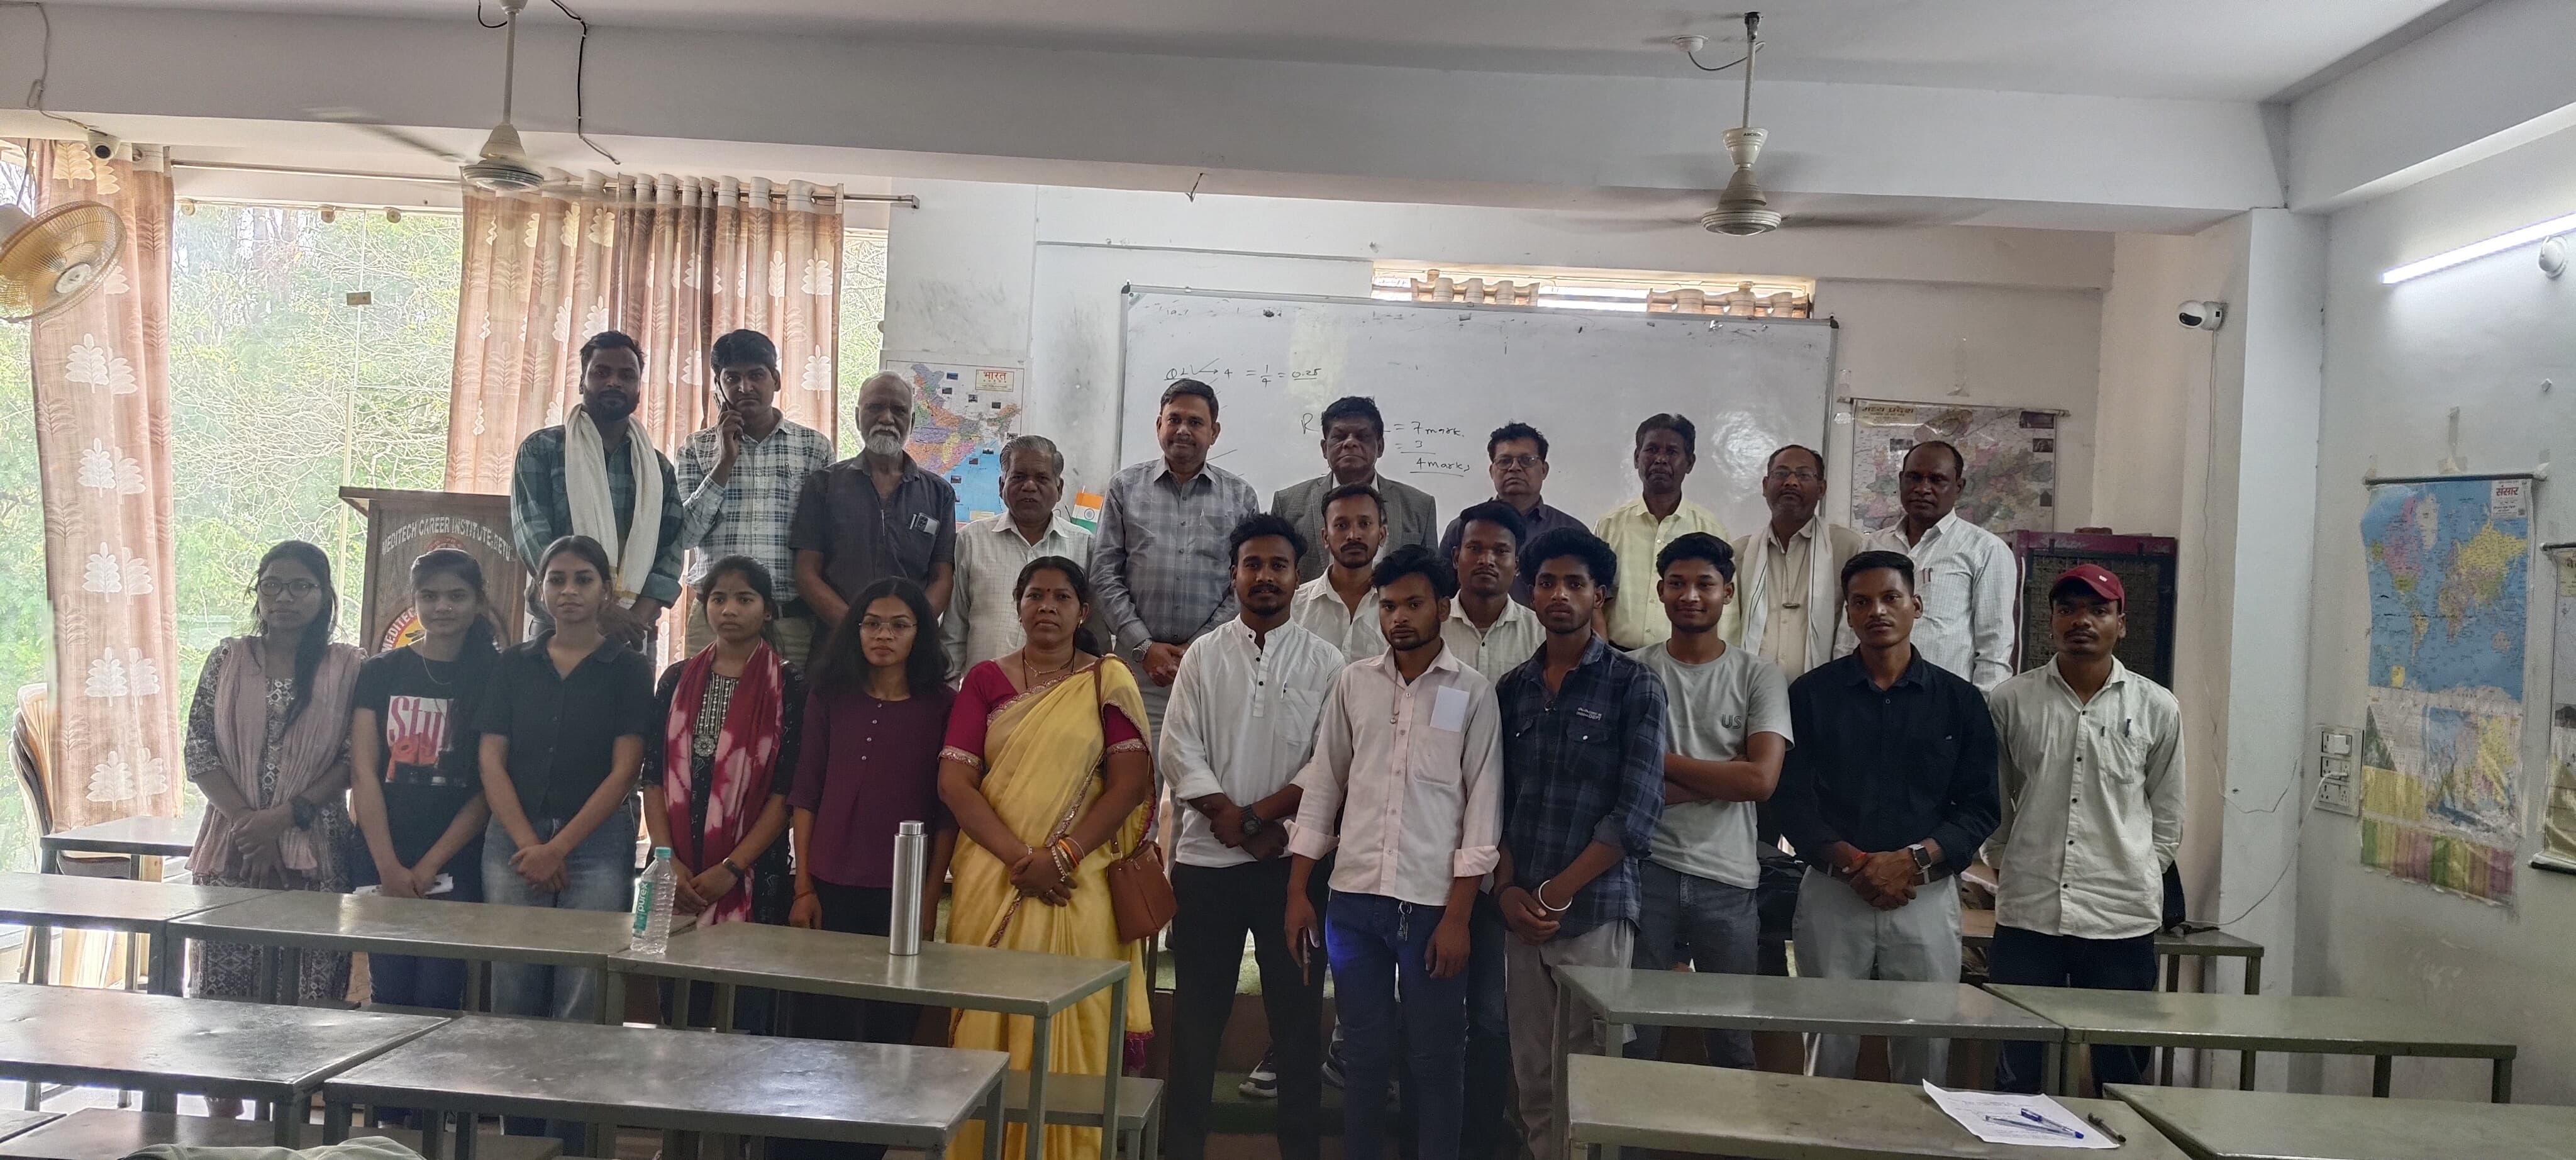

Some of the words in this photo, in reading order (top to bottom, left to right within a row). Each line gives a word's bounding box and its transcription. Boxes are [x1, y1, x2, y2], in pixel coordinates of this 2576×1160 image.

[984, 371, 1008, 381] भारत
[1224, 369, 1233, 380] 4
[1291, 368, 1322, 378] 0.25
[2496, 484, 2519, 496] संसार
[382, 521, 417, 556] MEDITECH
[419, 516, 450, 536] CAREER
[381, 606, 418, 652] MEDITEC
[1721, 713, 1742, 729] US
[637, 882, 648, 913] purex
